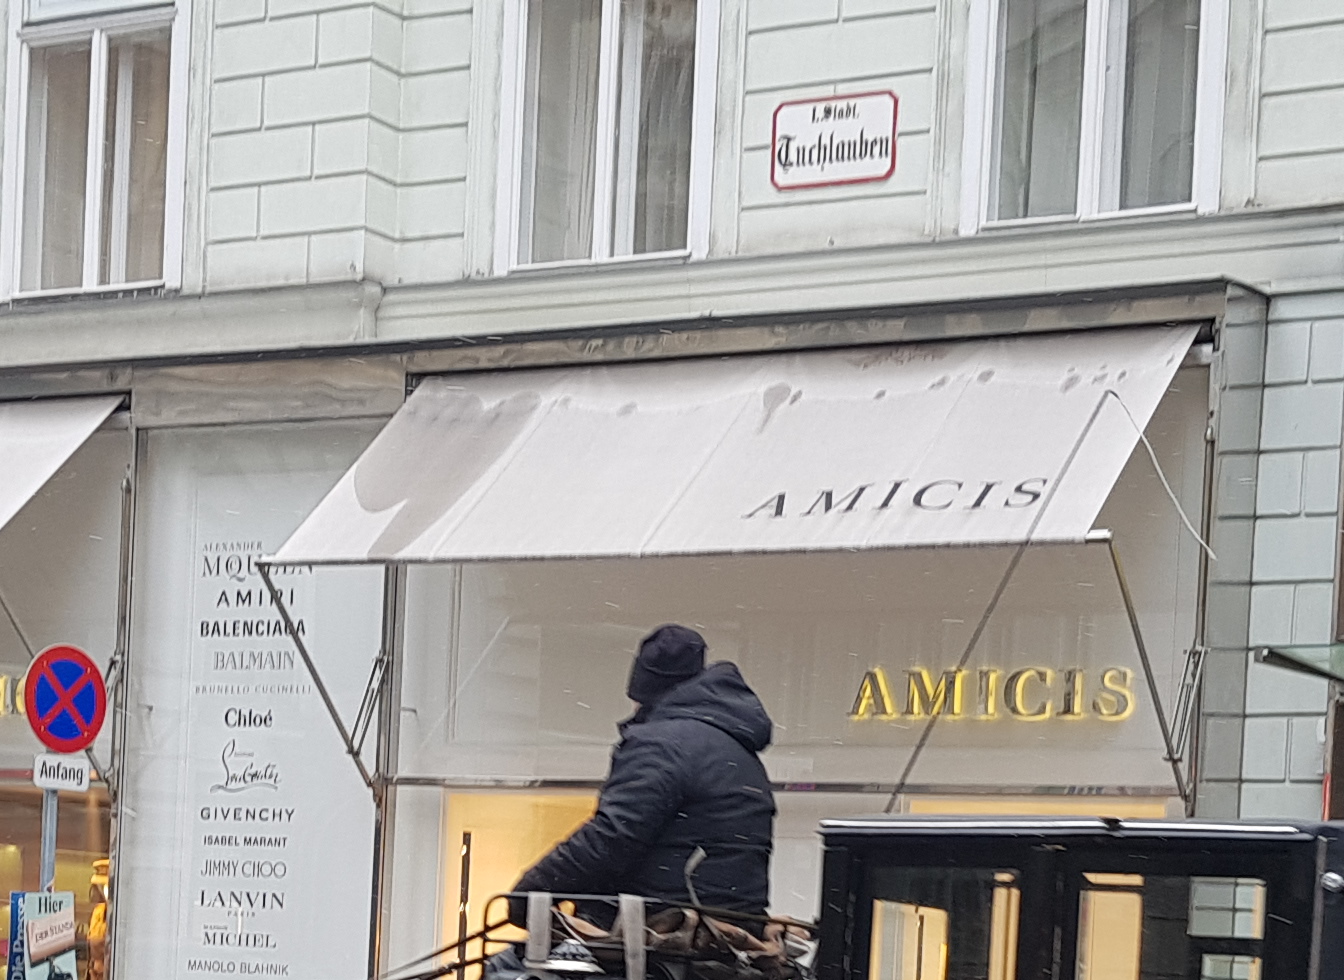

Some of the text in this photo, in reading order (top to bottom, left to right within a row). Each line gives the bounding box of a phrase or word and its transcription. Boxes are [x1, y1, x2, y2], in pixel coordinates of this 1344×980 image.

[777, 126, 890, 174] Tuchlauben
[740, 477, 1049, 520] AMICIS
[202, 541, 263, 552] ALEXANDER
[213, 650, 295, 671] BALMAIN
[843, 665, 1137, 722] AMICIS
[224, 707, 273, 728] Chloé
[39, 759, 85, 787] Anfang
[200, 806, 295, 823] GIVENCHY
[203, 835, 288, 849] ISABEL MARANT
[200, 859, 287, 879] JIMMY CHOO
[38, 894, 63, 914] Hier
[199, 889, 285, 910] LANVIN
[203, 931, 278, 949] MICHEL
[187, 959, 290, 977] MANOLO BLAHNIK
